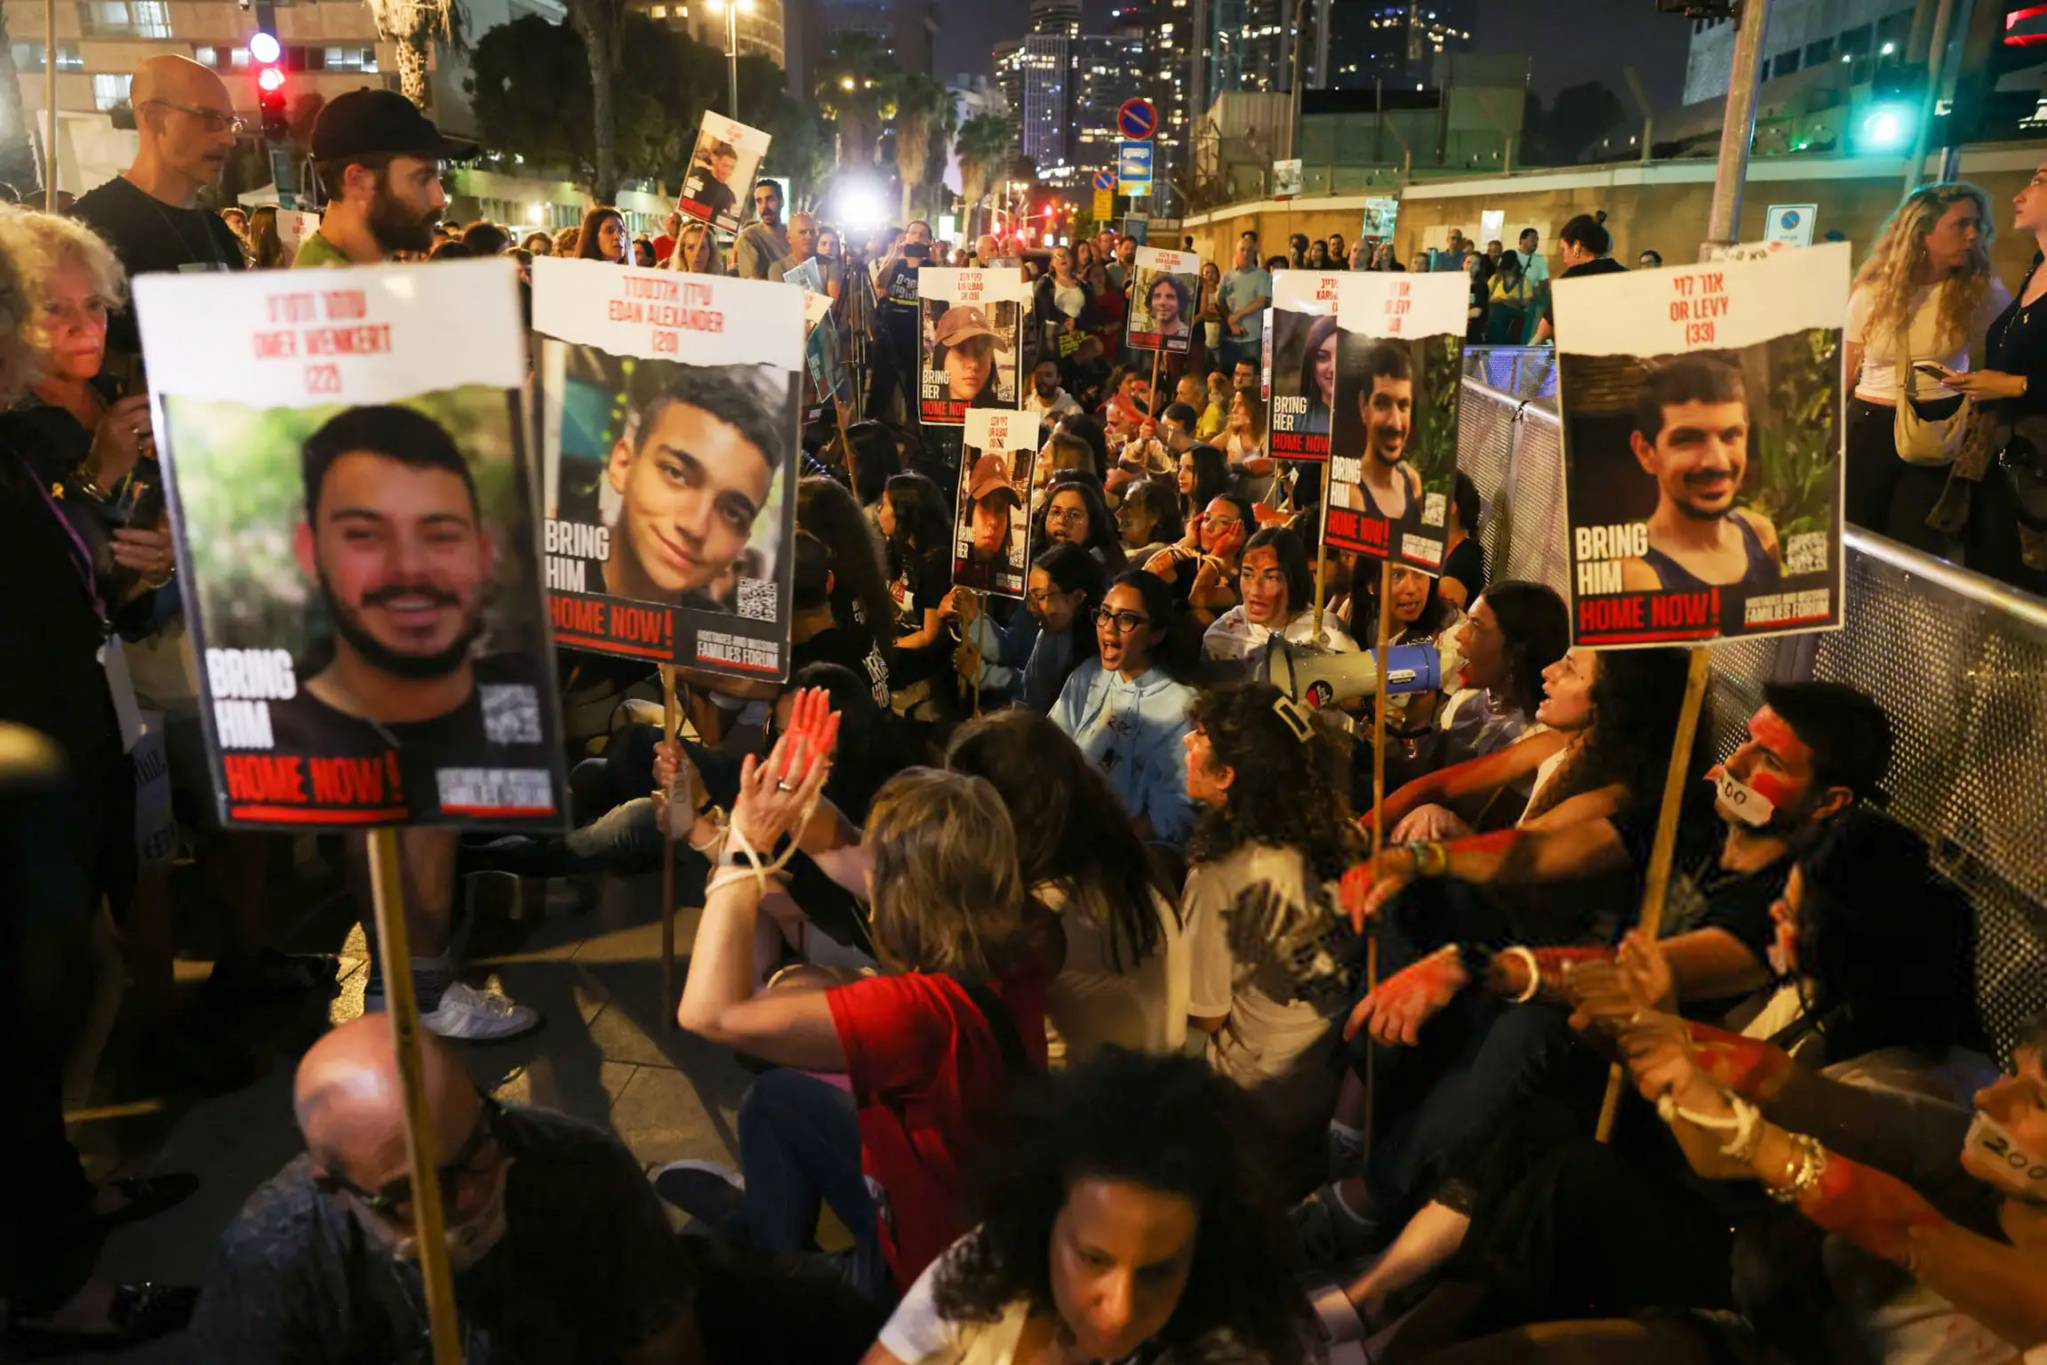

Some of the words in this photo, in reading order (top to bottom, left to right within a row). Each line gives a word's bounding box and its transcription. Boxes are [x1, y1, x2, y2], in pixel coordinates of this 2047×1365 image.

[1673, 274, 1694, 296] לוי
[1697, 272, 1724, 294] אור
[609, 299, 642, 323] EDAN
[647, 303, 723, 333] ALEXANDER
[1670, 301, 1689, 322] OR
[1693, 295, 1729, 319] LEVY
[1686, 320, 1714, 346] (33)
[922, 370, 950, 385] BRING
[922, 384, 939, 399] HER
[922, 400, 947, 417] HOME
[1273, 396, 1307, 415] BRING
[1272, 414, 1294, 431] HER
[1272, 432, 1303, 451] HOME
[1305, 434, 1330, 453] NOW
[544, 518, 609, 561] BRING
[1575, 522, 1648, 561] BRING
[545, 555, 586, 593] HIM
[1577, 561, 1622, 595] HIM
[547, 594, 605, 635] HOME
[610, 604, 673, 647] NOW!
[1579, 597, 1645, 632] HOME
[1651, 586, 1720, 625] NOW!
[696, 641, 742, 663] FAMILIES
[206, 647, 298, 700] BRING
[213, 700, 275, 749] HIM
[224, 754, 308, 804] HOME
[309, 748, 404, 804] NOW!
